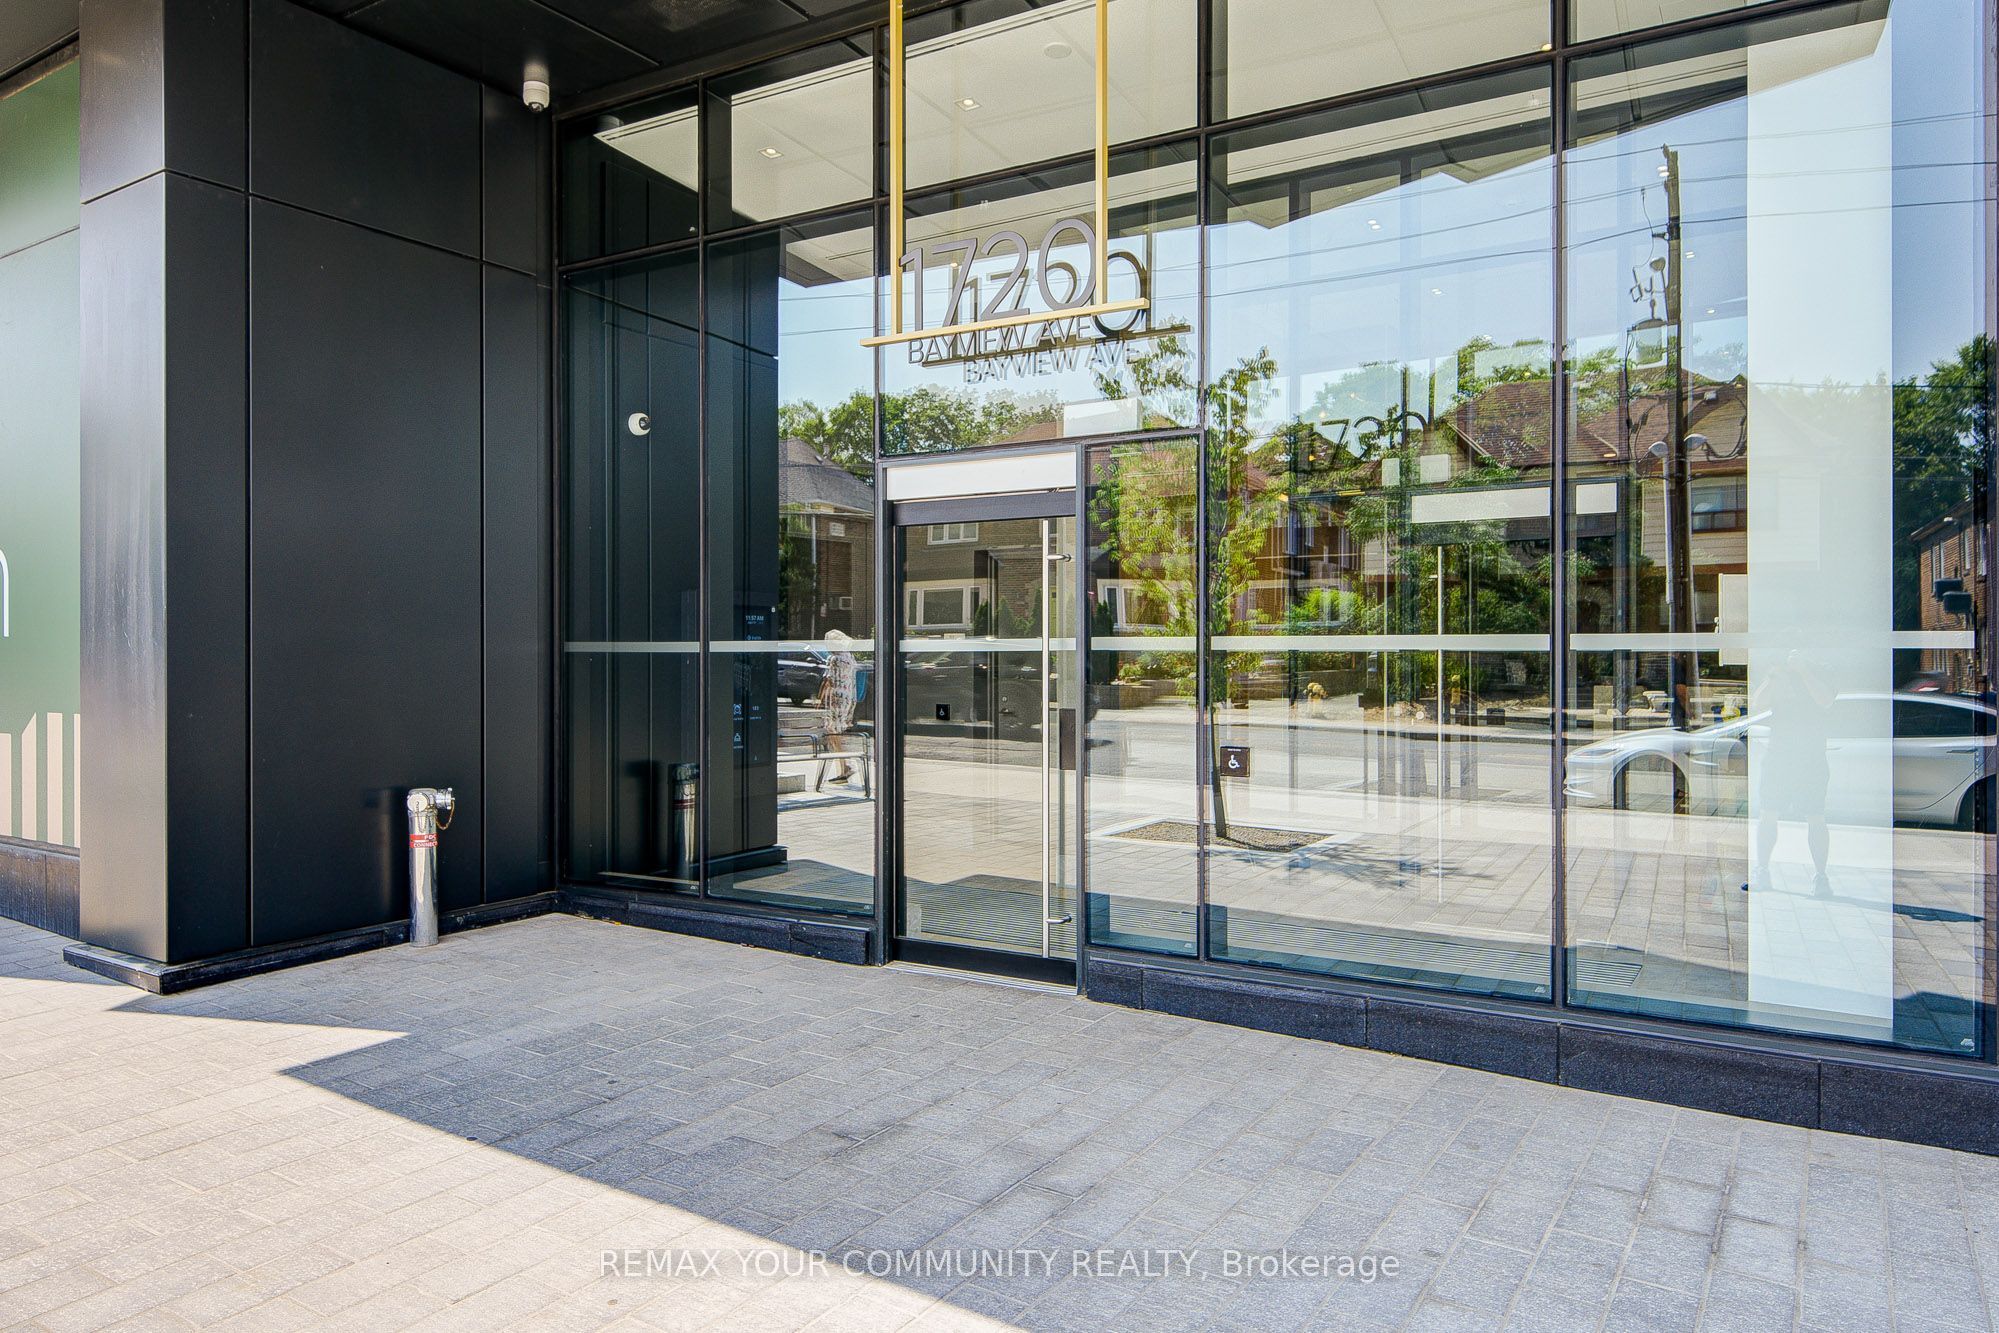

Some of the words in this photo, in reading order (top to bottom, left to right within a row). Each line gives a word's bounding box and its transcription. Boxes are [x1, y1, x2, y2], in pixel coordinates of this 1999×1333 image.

[899, 218, 1096, 332] 1720
[908, 323, 1030, 364] BAYVIEW
[1036, 314, 1092, 347] AVE
